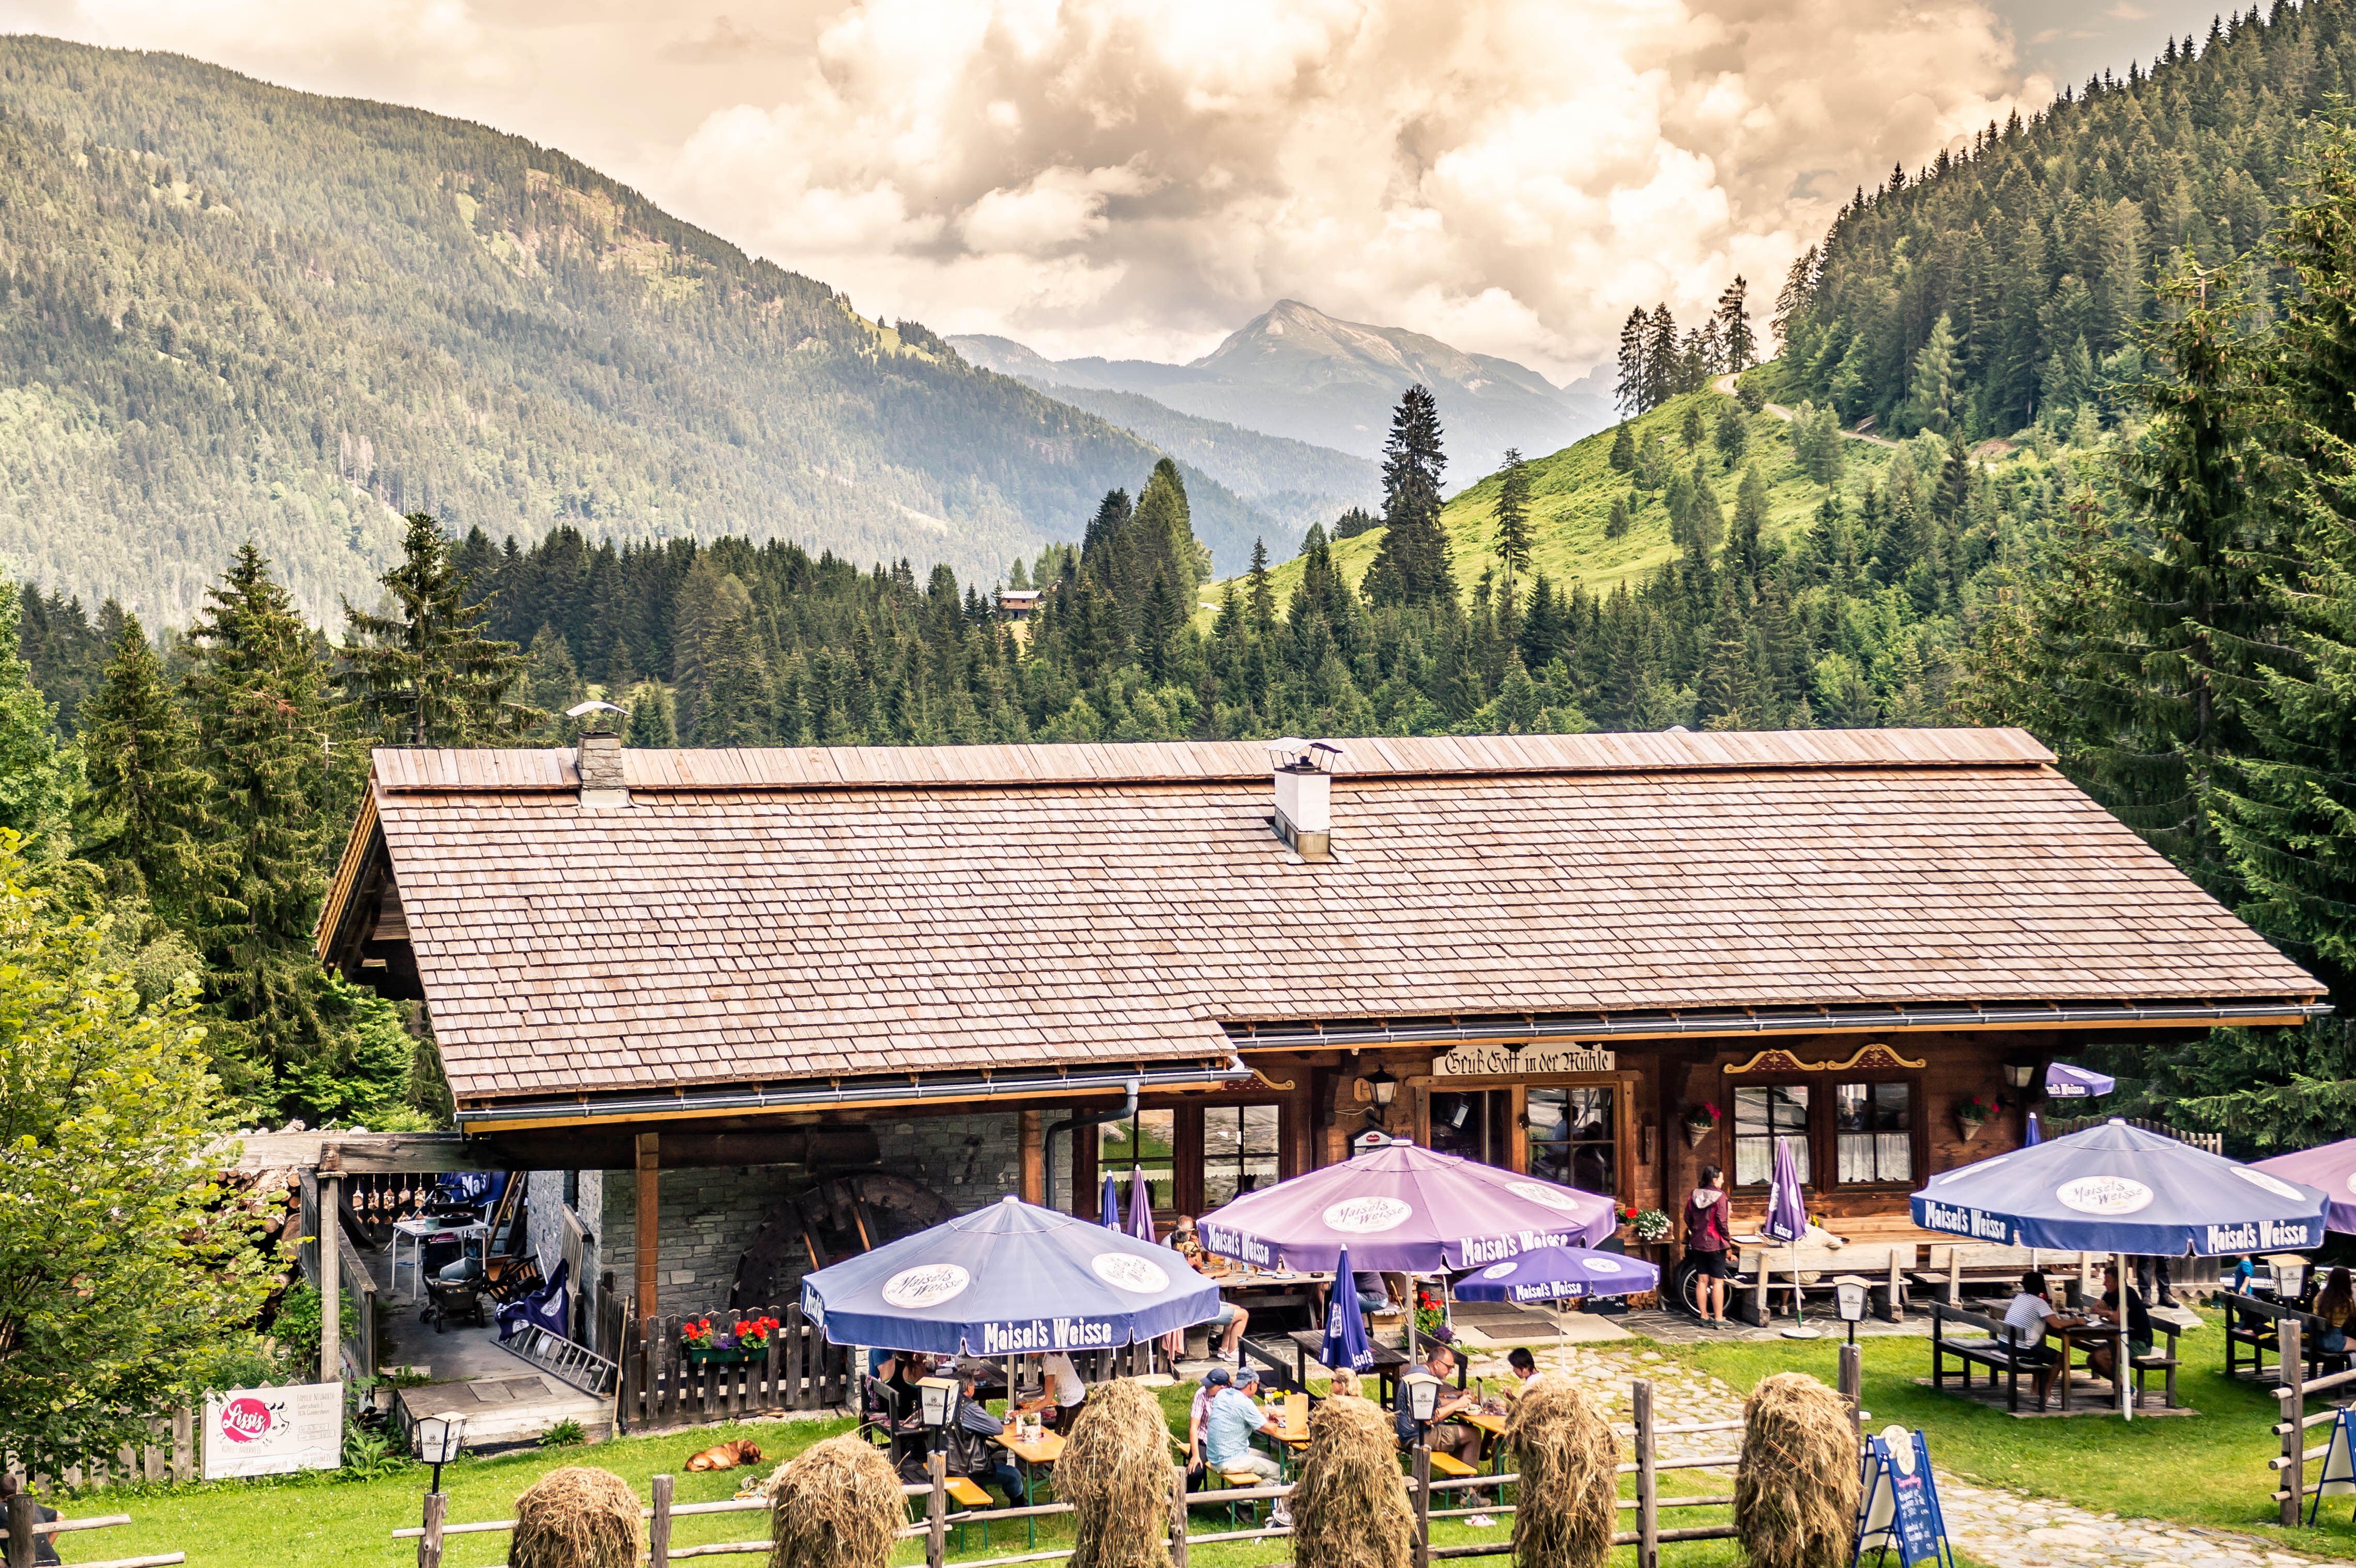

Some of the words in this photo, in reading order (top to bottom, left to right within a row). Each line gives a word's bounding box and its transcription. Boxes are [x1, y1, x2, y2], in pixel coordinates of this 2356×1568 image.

[1445, 1048, 1485, 1074] Grüß
[1487, 1050, 1520, 1073] Gott
[1525, 1052, 1537, 1072] in
[1539, 1051, 1558, 1071] der
[1559, 1051, 1609, 1071] Mühle
[1925, 1200, 1969, 1233] Maisel's
[1970, 1208, 2006, 1240] Weisse
[2207, 1223, 2257, 1254] Maisel's
[2258, 1219, 2308, 1249] Weisse
[1207, 1223, 1240, 1256] Maisel's
[1242, 1232, 1269, 1266] Weisse
[1460, 1233, 1519, 1267] Maisel's
[1514, 1282, 1550, 1301] Maisel's
[1550, 1280, 1582, 1297] Weisse
[984, 1319, 1049, 1354] Maisel's
[1052, 1317, 1112, 1348] Weisse
[223, 1404, 266, 1439] Lissis
